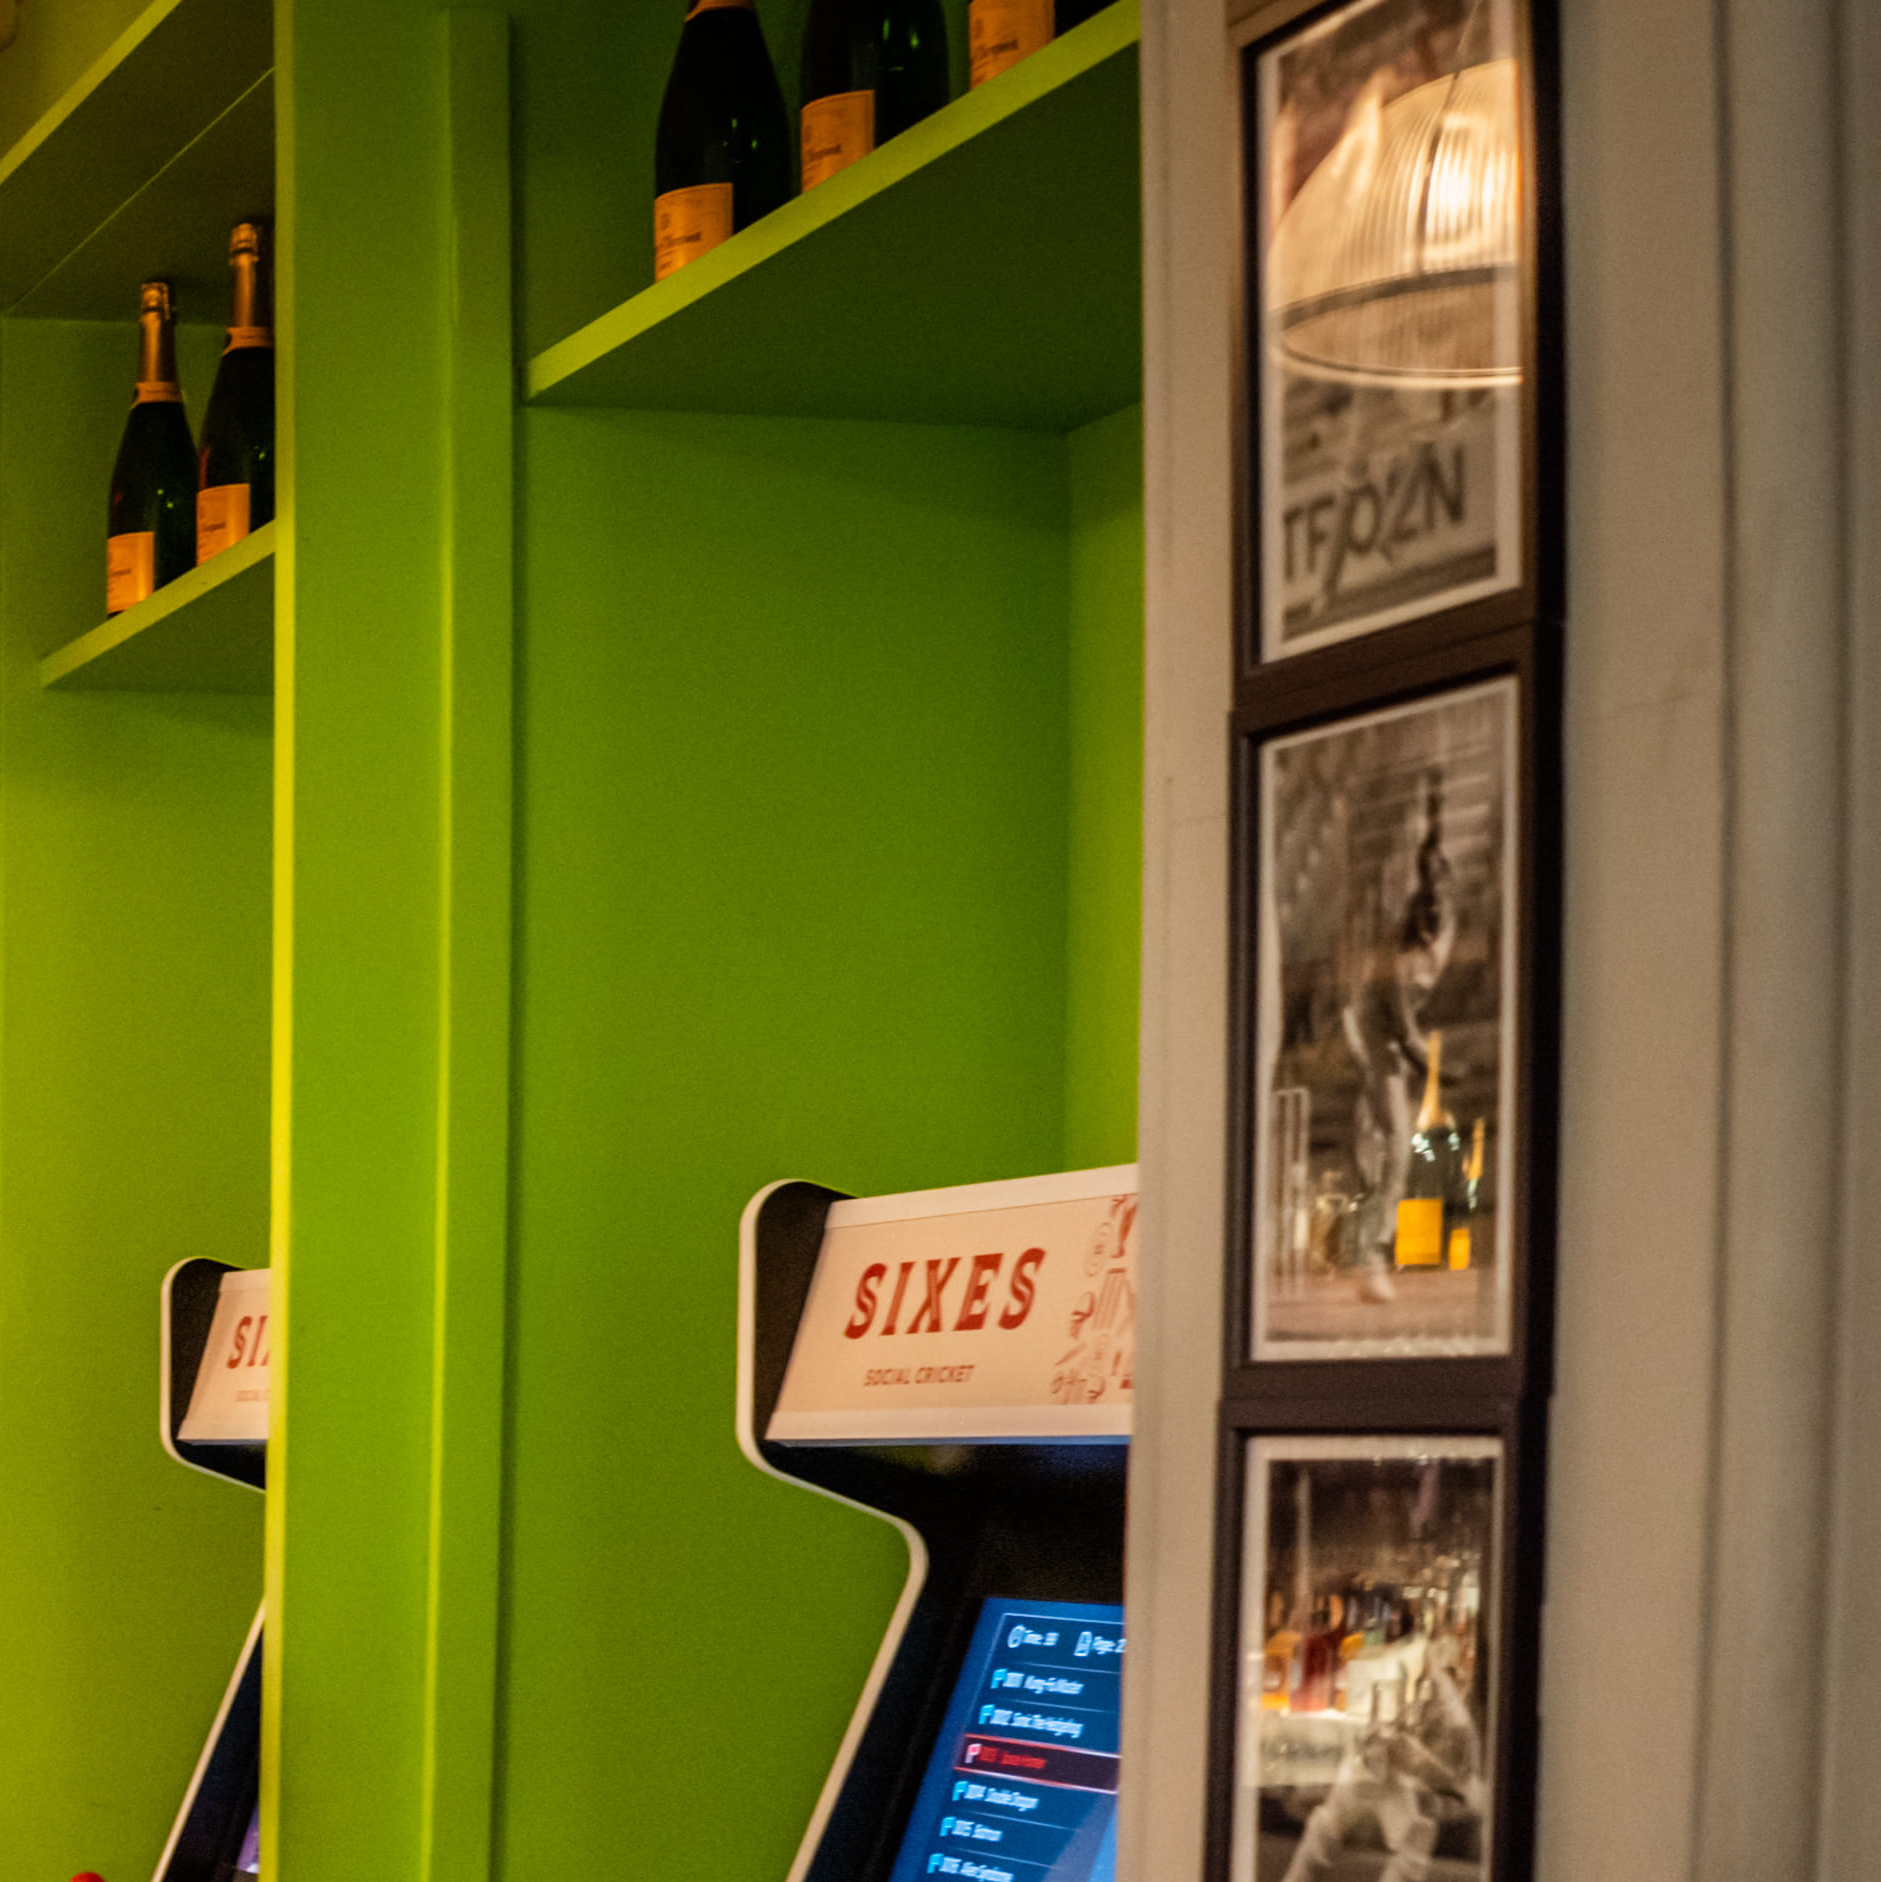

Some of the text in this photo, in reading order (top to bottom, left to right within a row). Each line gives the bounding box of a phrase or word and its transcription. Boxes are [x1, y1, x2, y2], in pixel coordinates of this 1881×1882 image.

[845, 1246, 1047, 1340] SIXES
[226, 1314, 270, 1370] SI
[863, 1364, 976, 1387] SOCIAL CRICKET
